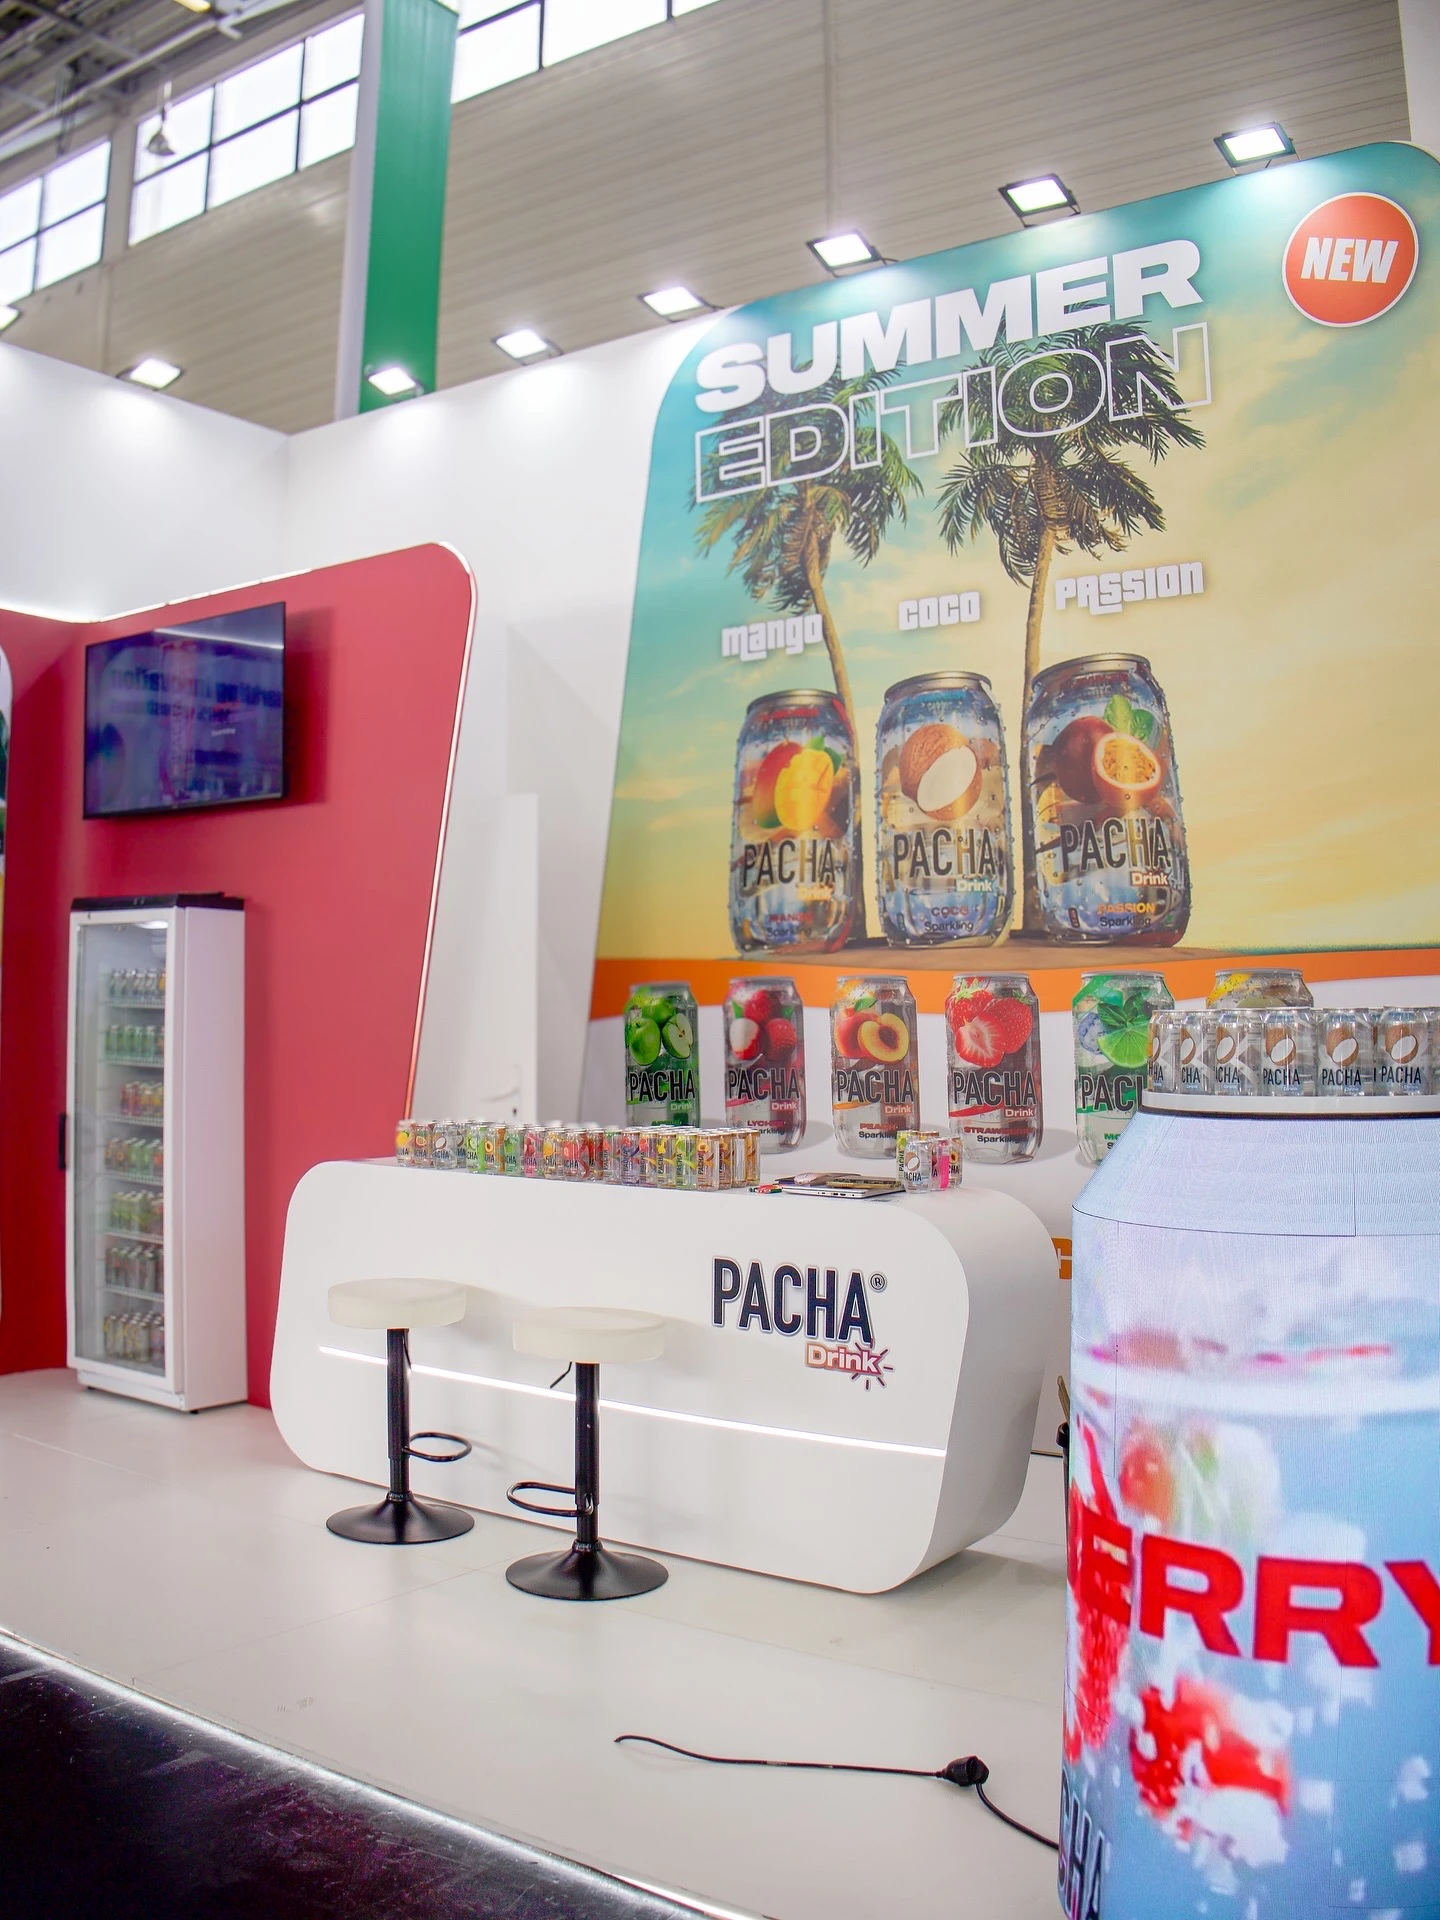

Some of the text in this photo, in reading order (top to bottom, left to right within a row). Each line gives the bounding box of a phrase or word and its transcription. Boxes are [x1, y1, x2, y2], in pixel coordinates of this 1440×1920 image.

[1301, 236, 1399, 284] NEW
[695, 240, 1203, 413] SUMMER
[696, 322, 1212, 502] EDITION
[1055, 561, 1204, 615] PASSION
[899, 591, 980, 631] COCO
[893, 828, 996, 880] PACHA
[1060, 817, 1171, 873] PACHA
[744, 839, 836, 887] PACHA
[957, 879, 993, 892] Drink
[1131, 871, 1169, 887] Drink
[1097, 902, 1155, 915] PASSION
[924, 920, 974, 932] Sparkling
[629, 1069, 696, 1101] PACHA
[730, 1069, 800, 1099] PACHA
[837, 1070, 914, 1104] PACHA
[1263, 1067, 1300, 1086] PACHA
[1321, 1068, 1361, 1086] PACHA
[1381, 1066, 1421, 1084] PACHA
[953, 1071, 1037, 1106] PACHA
[670, 1102, 694, 1111] Drink
[771, 1102, 797, 1111] Drink
[884, 1104, 912, 1114] Drink
[1005, 1108, 1034, 1117] Drink
[858, 1131, 897, 1139] Sparkling
[977, 1134, 1020, 1143] Sparkling
[808, 1344, 881, 1373] Drink
